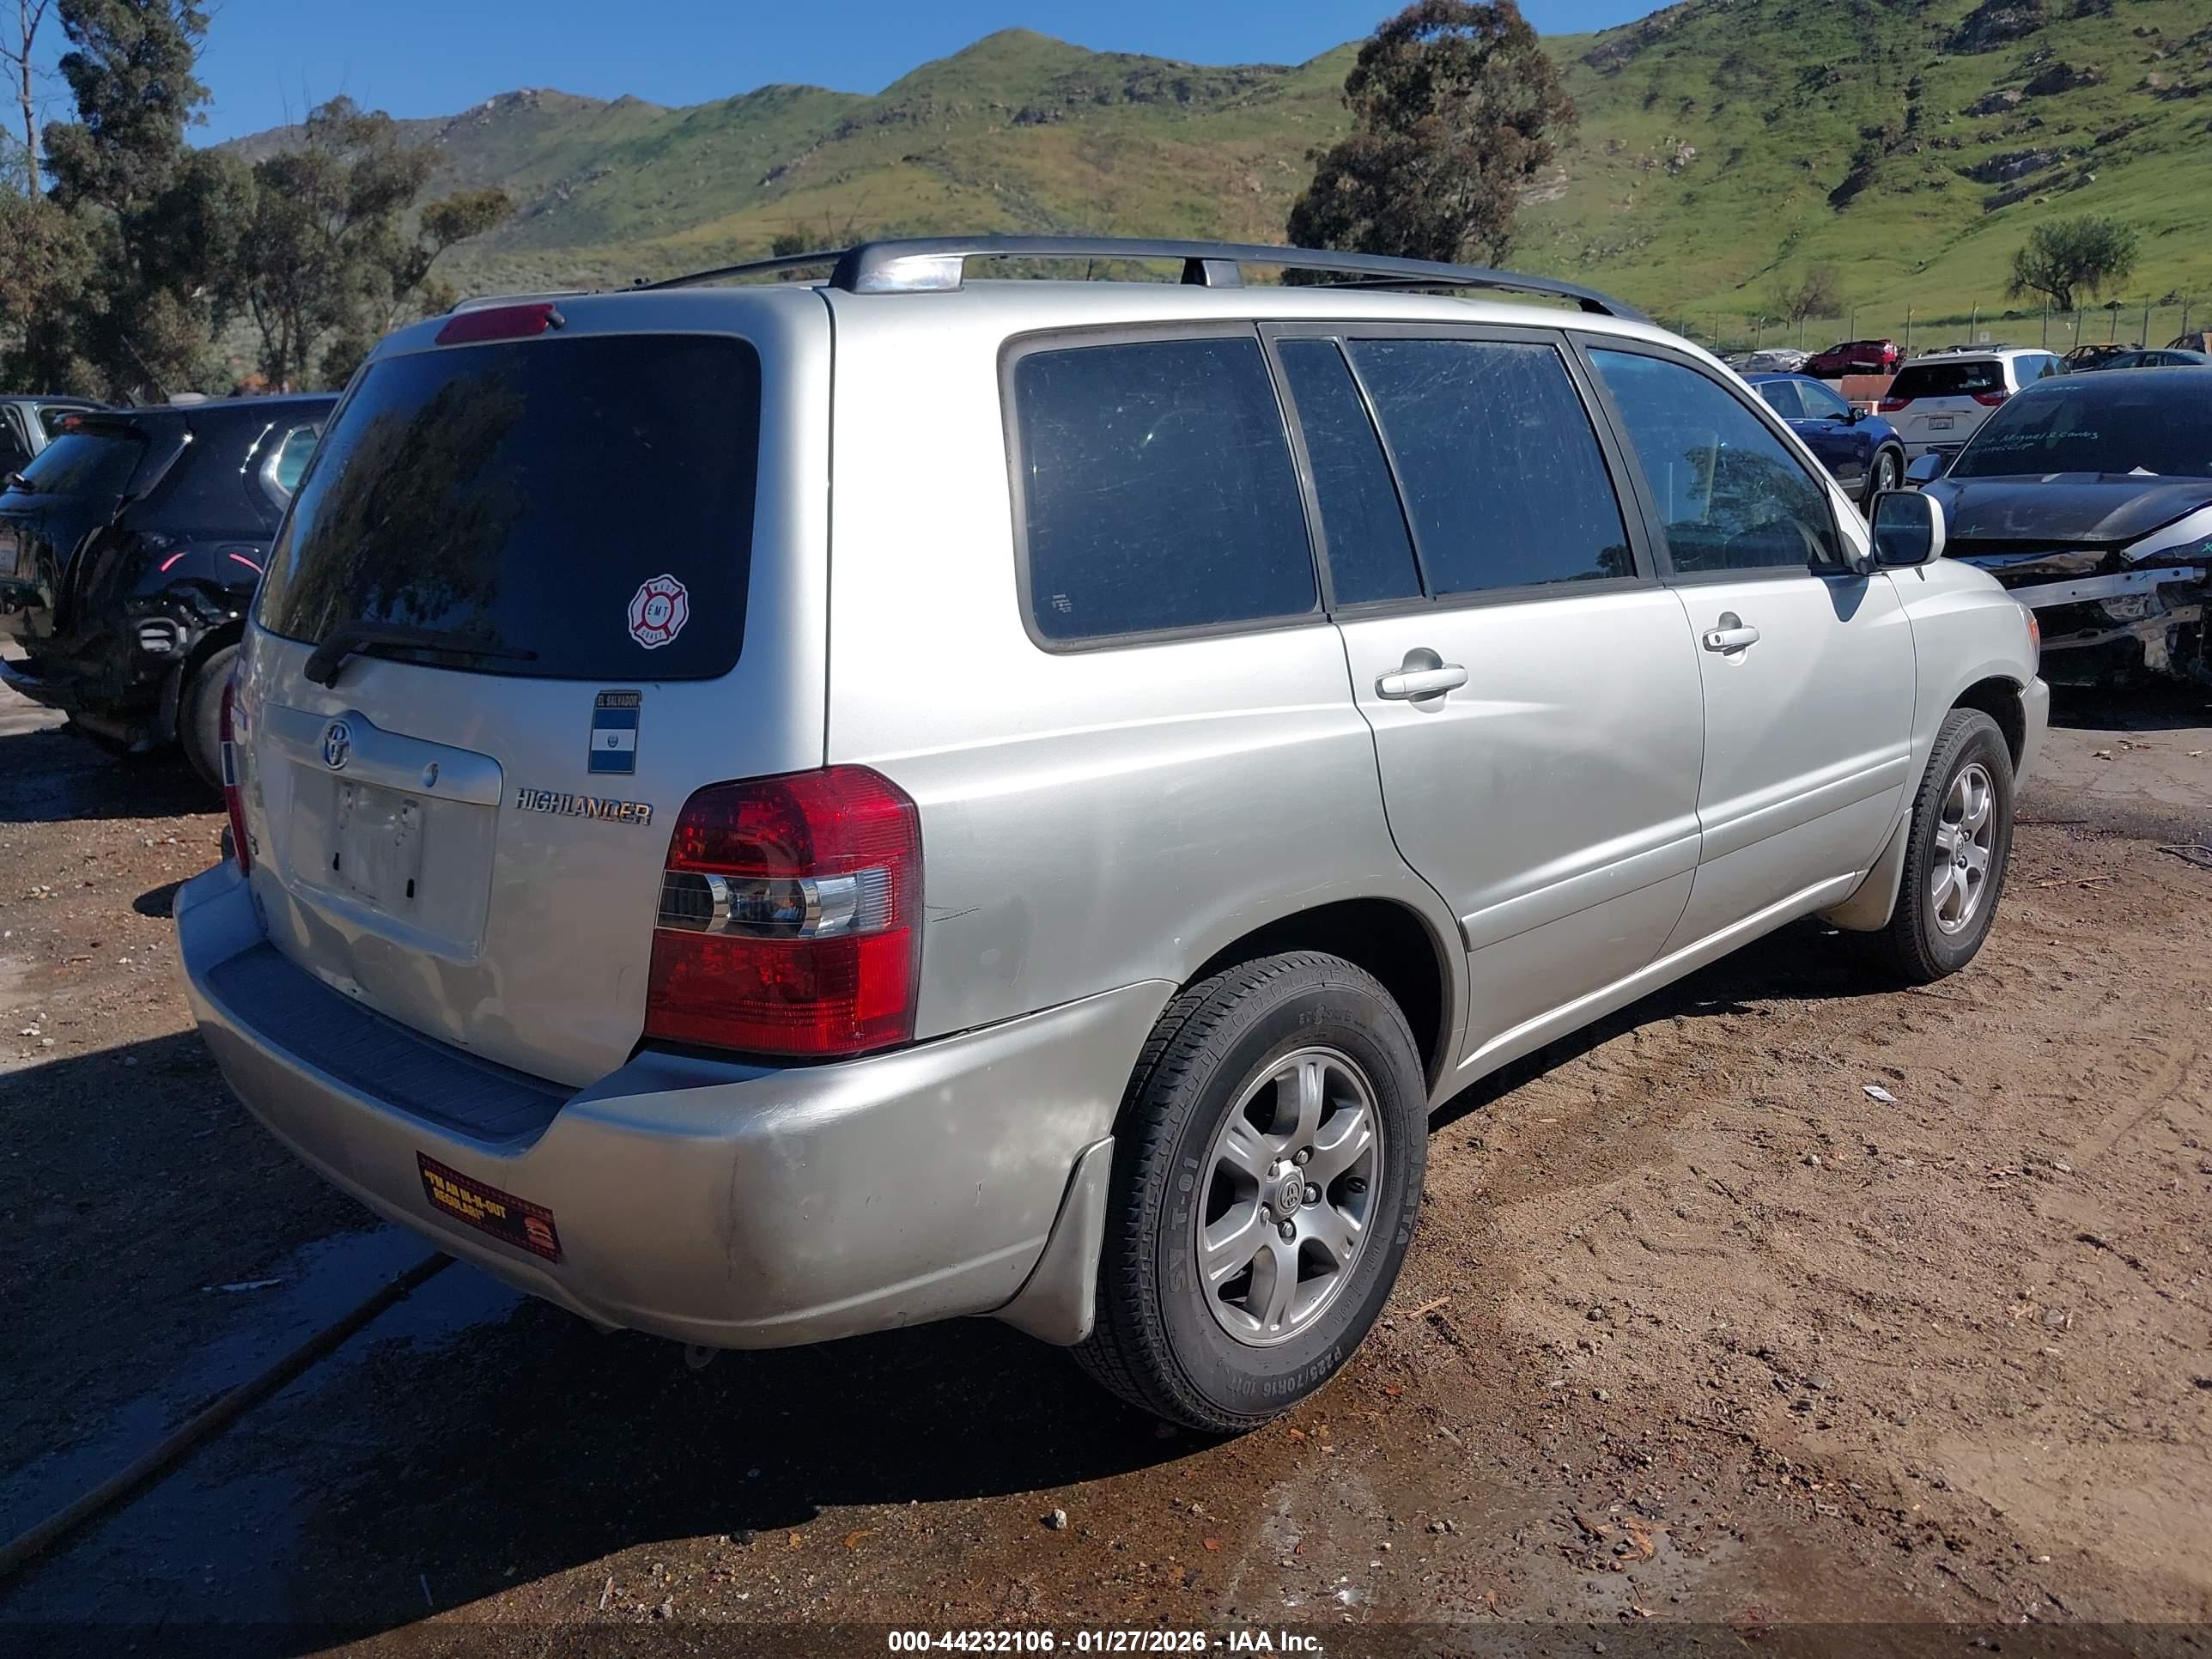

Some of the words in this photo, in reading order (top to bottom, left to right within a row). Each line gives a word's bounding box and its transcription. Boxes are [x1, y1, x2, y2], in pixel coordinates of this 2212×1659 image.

[647, 604, 671, 618] EMT
[597, 695, 605, 707] EL
[606, 695, 639, 708] SALVADOR
[514, 787, 653, 826] HIGHLANDER
[446, 1181, 460, 1199] AN
[459, 1188, 507, 1219] IN-N-OUT
